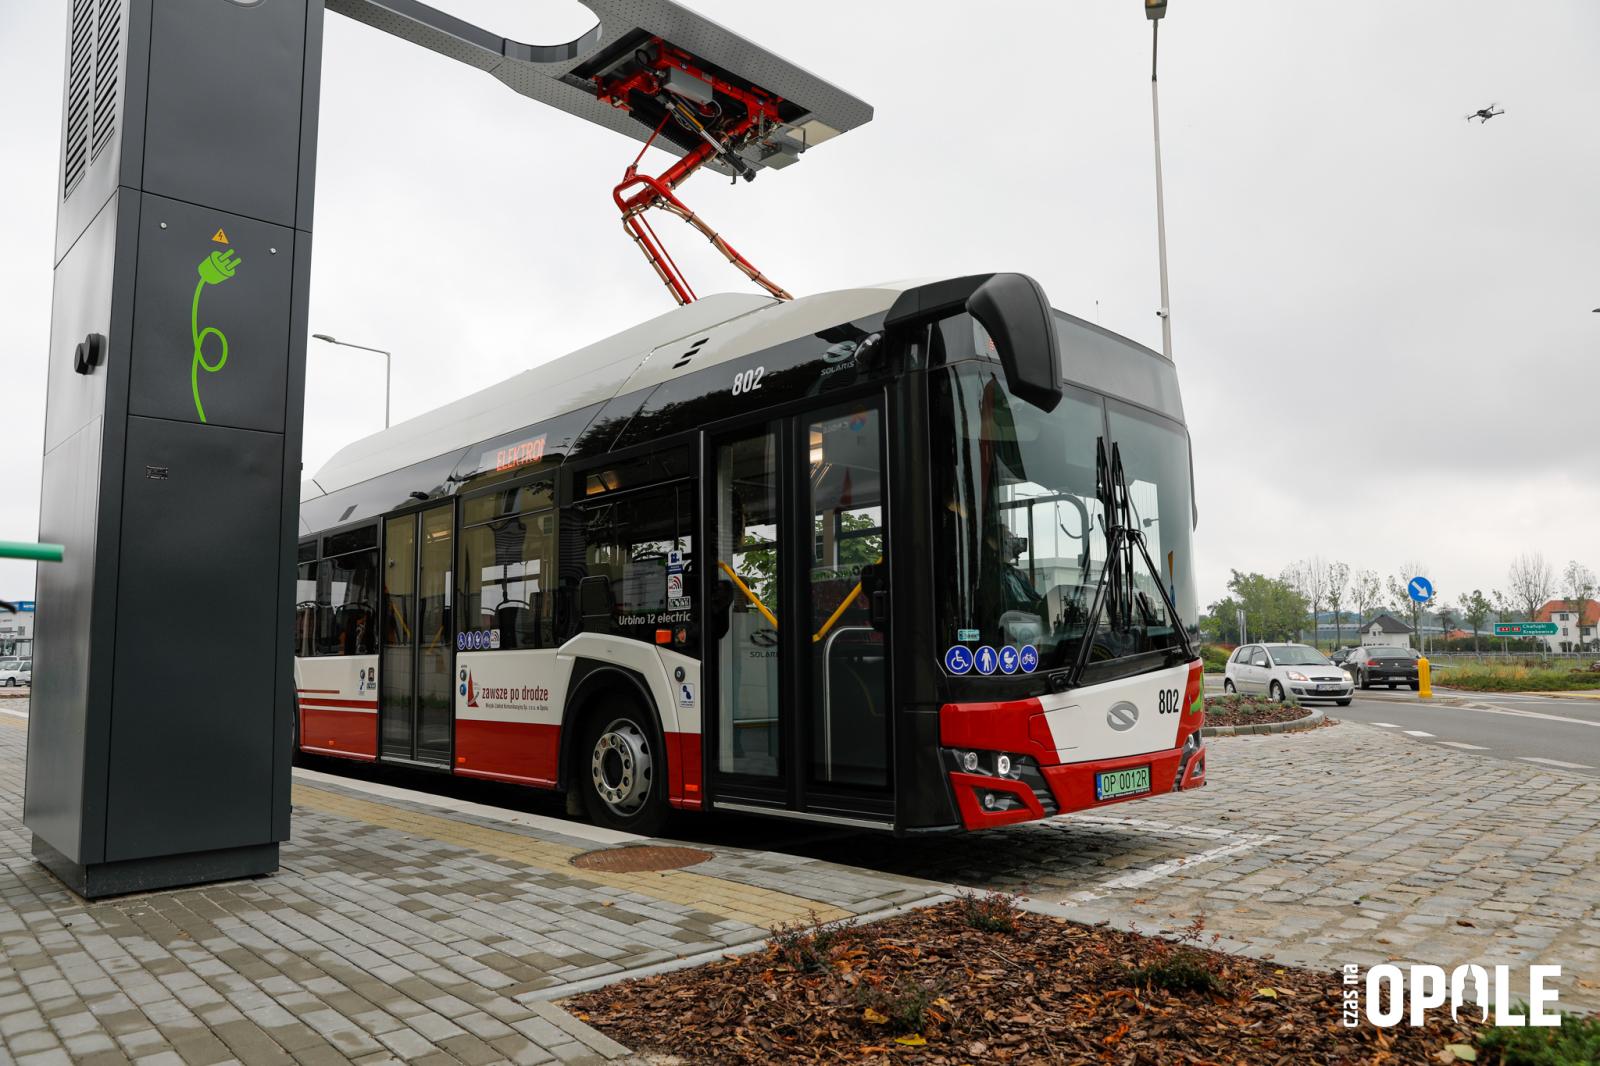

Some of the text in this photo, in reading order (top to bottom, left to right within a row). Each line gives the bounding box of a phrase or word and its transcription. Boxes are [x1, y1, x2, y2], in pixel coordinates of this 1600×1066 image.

[820, 360, 855, 376] SOLARIS
[732, 366, 765, 396] 802
[619, 611, 691, 626] Urbino 12 electric
[482, 685, 549, 703] zawsze po drodze
[1158, 688, 1179, 714] 802
[1103, 769, 1148, 793] OP 0012R
